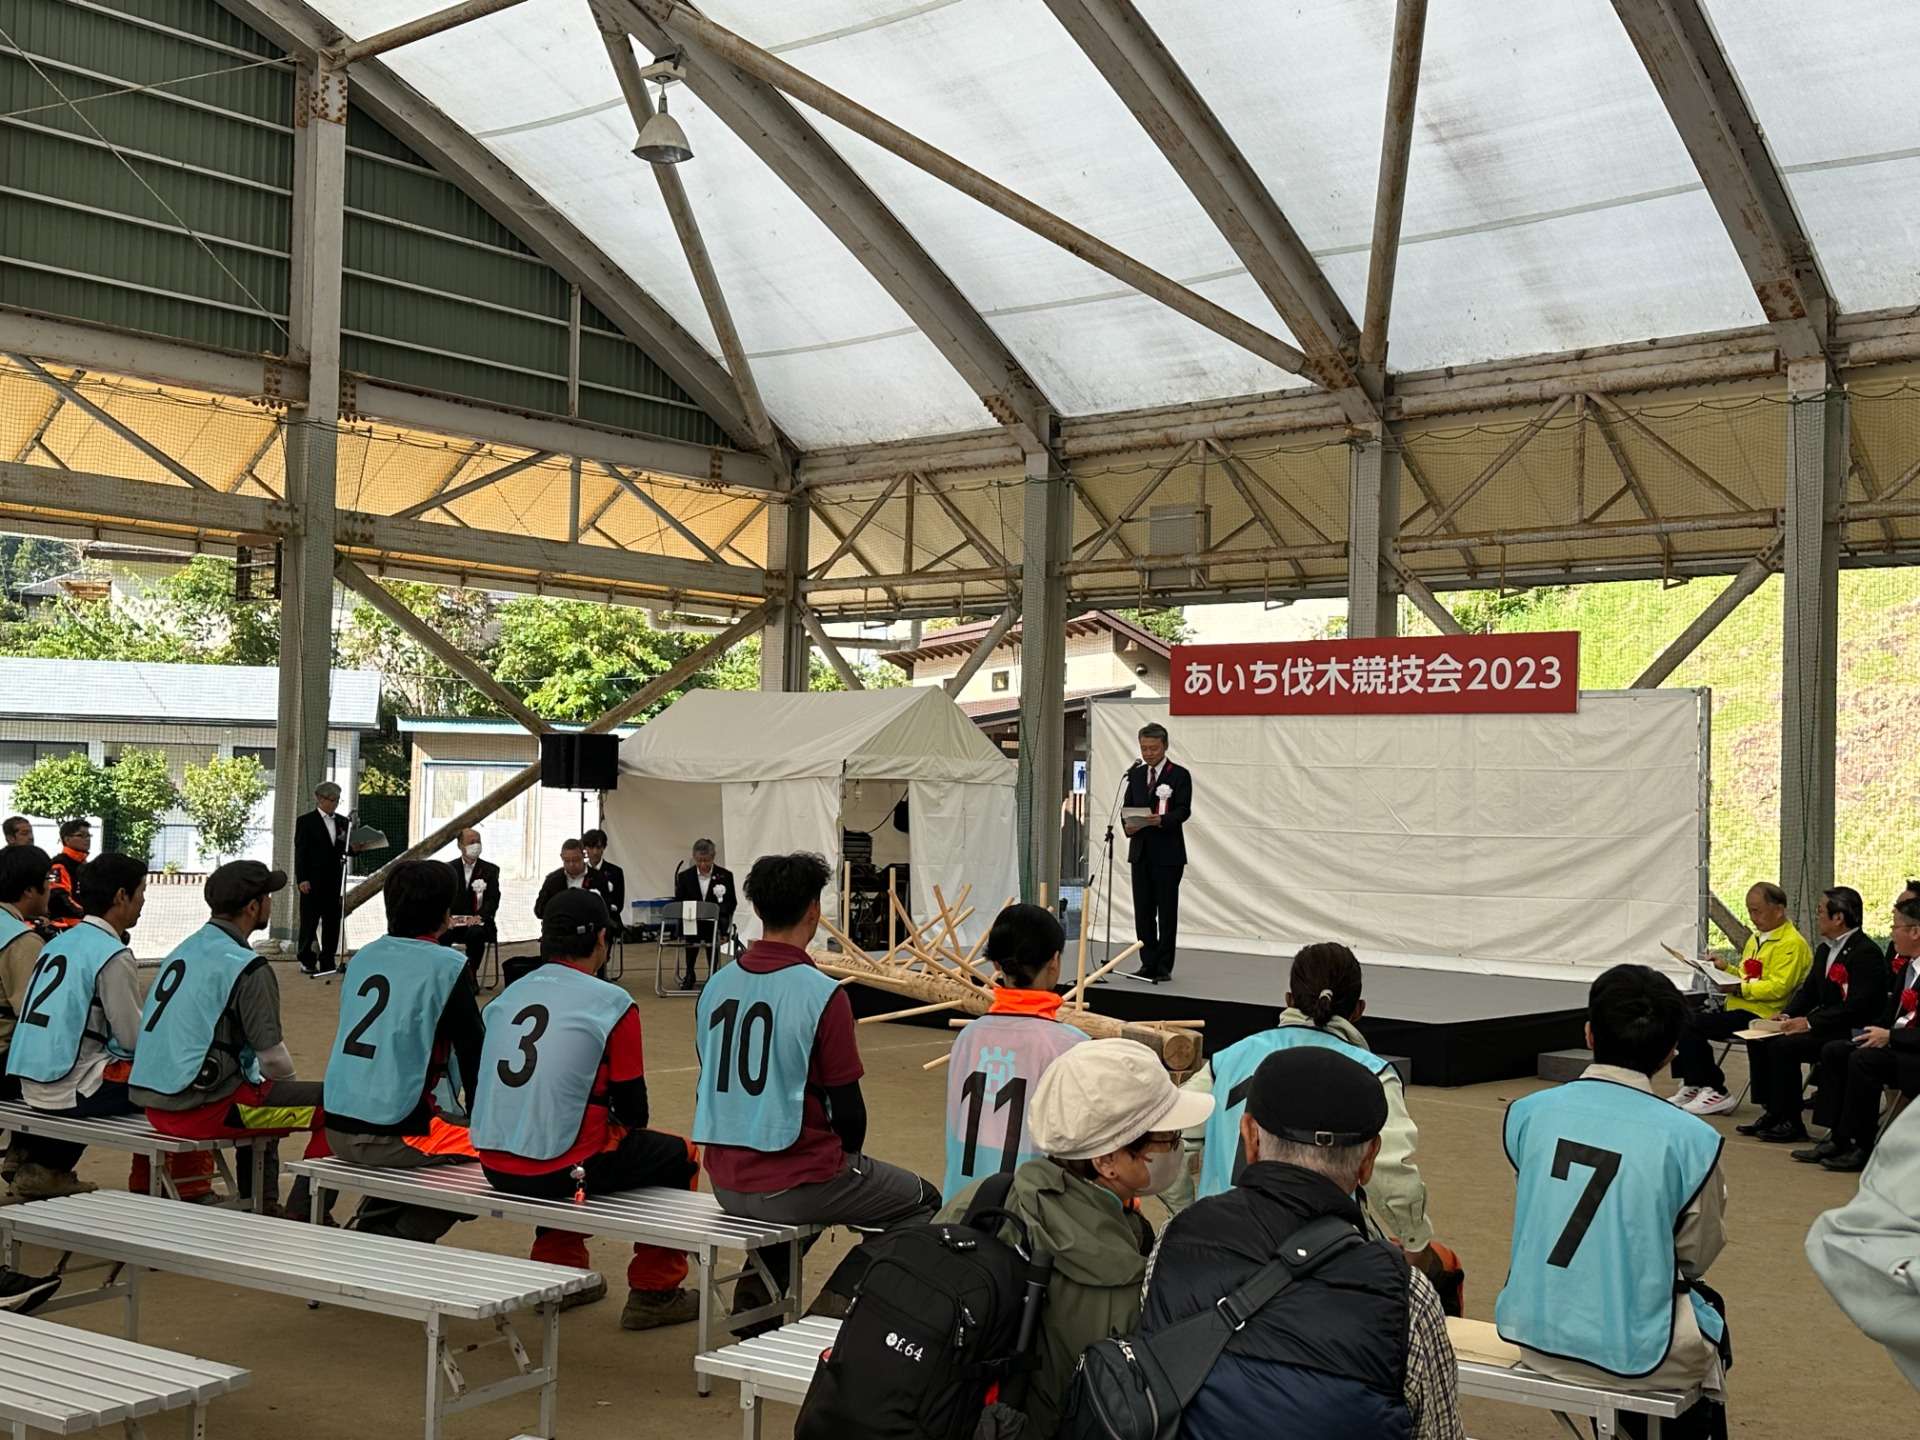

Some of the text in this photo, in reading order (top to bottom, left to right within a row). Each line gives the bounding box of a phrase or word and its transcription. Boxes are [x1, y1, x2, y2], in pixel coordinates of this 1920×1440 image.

[1184, 653, 1562, 696] あいち伐木競技会2023
[20, 953, 68, 1028] 12
[144, 959, 186, 1032] 9
[342, 974, 391, 1060] 2
[497, 1003, 550, 1088] 3
[709, 998, 773, 1096] 10
[960, 1070, 1027, 1177] 11
[1547, 1138, 1622, 1269] 7
